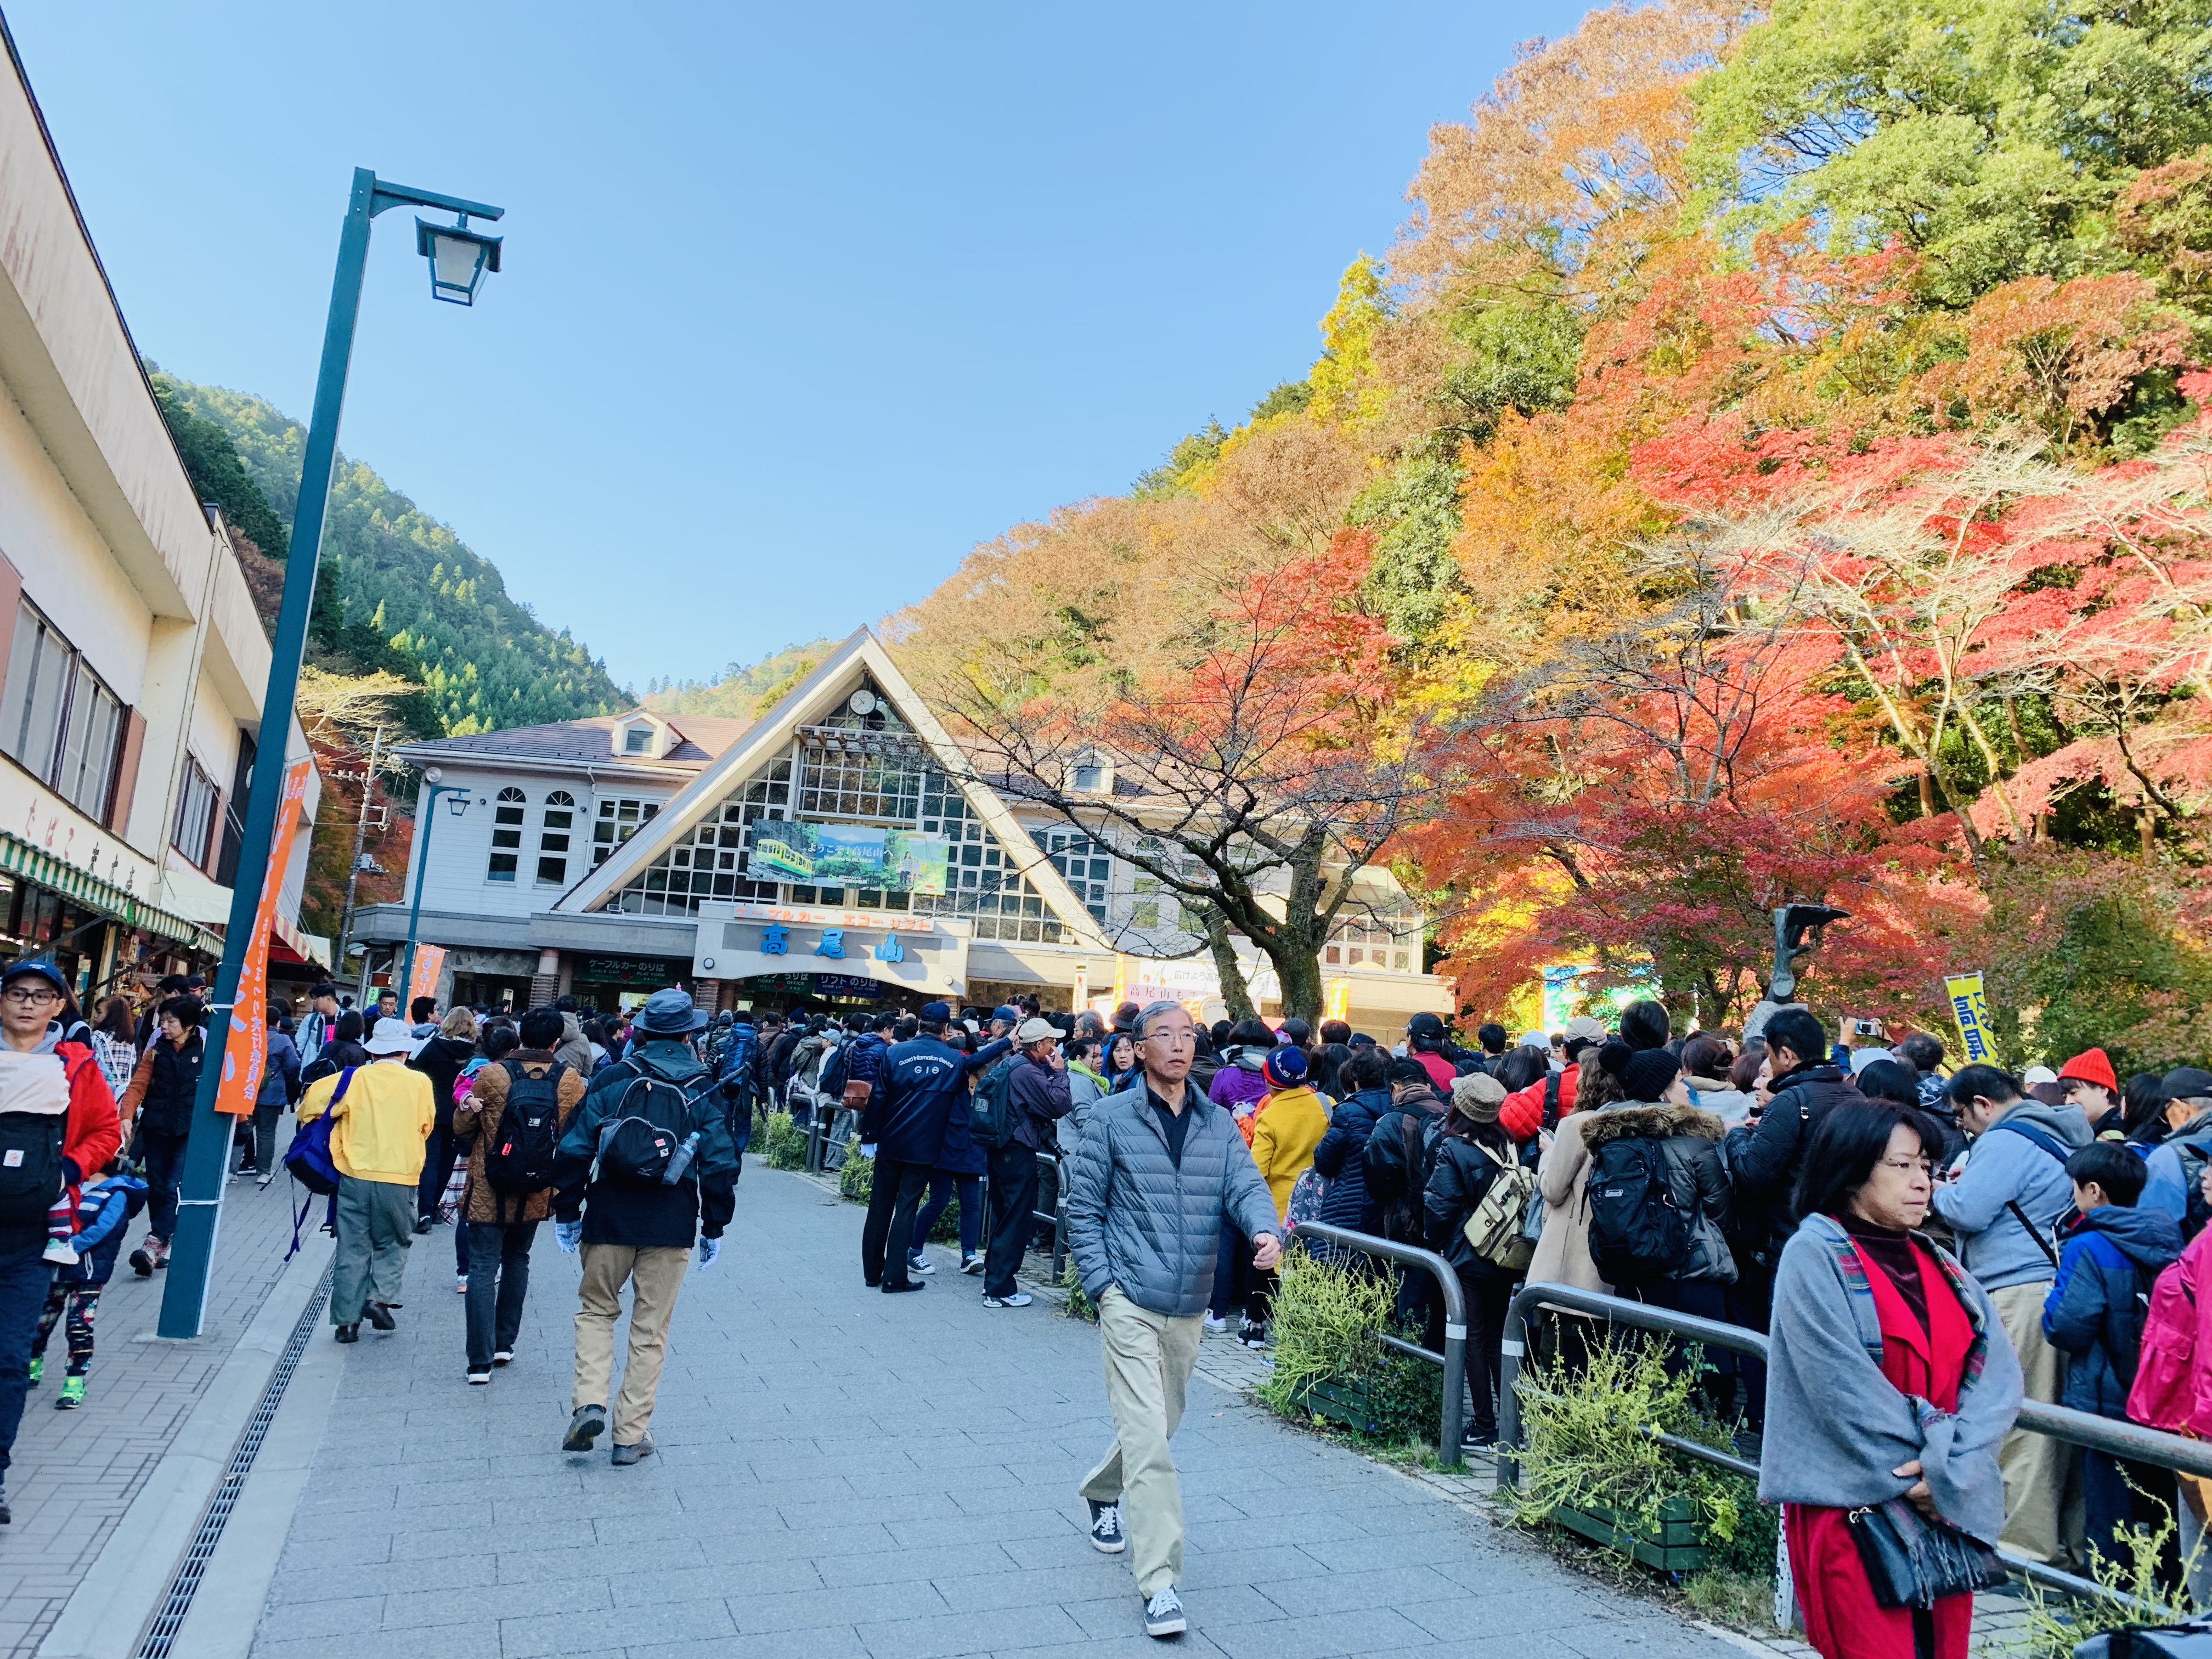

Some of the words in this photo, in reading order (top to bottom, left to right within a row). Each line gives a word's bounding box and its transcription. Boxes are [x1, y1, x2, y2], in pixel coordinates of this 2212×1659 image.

[761, 923, 904, 962] 高尾山
[899, 1056, 913, 1065] Guard
